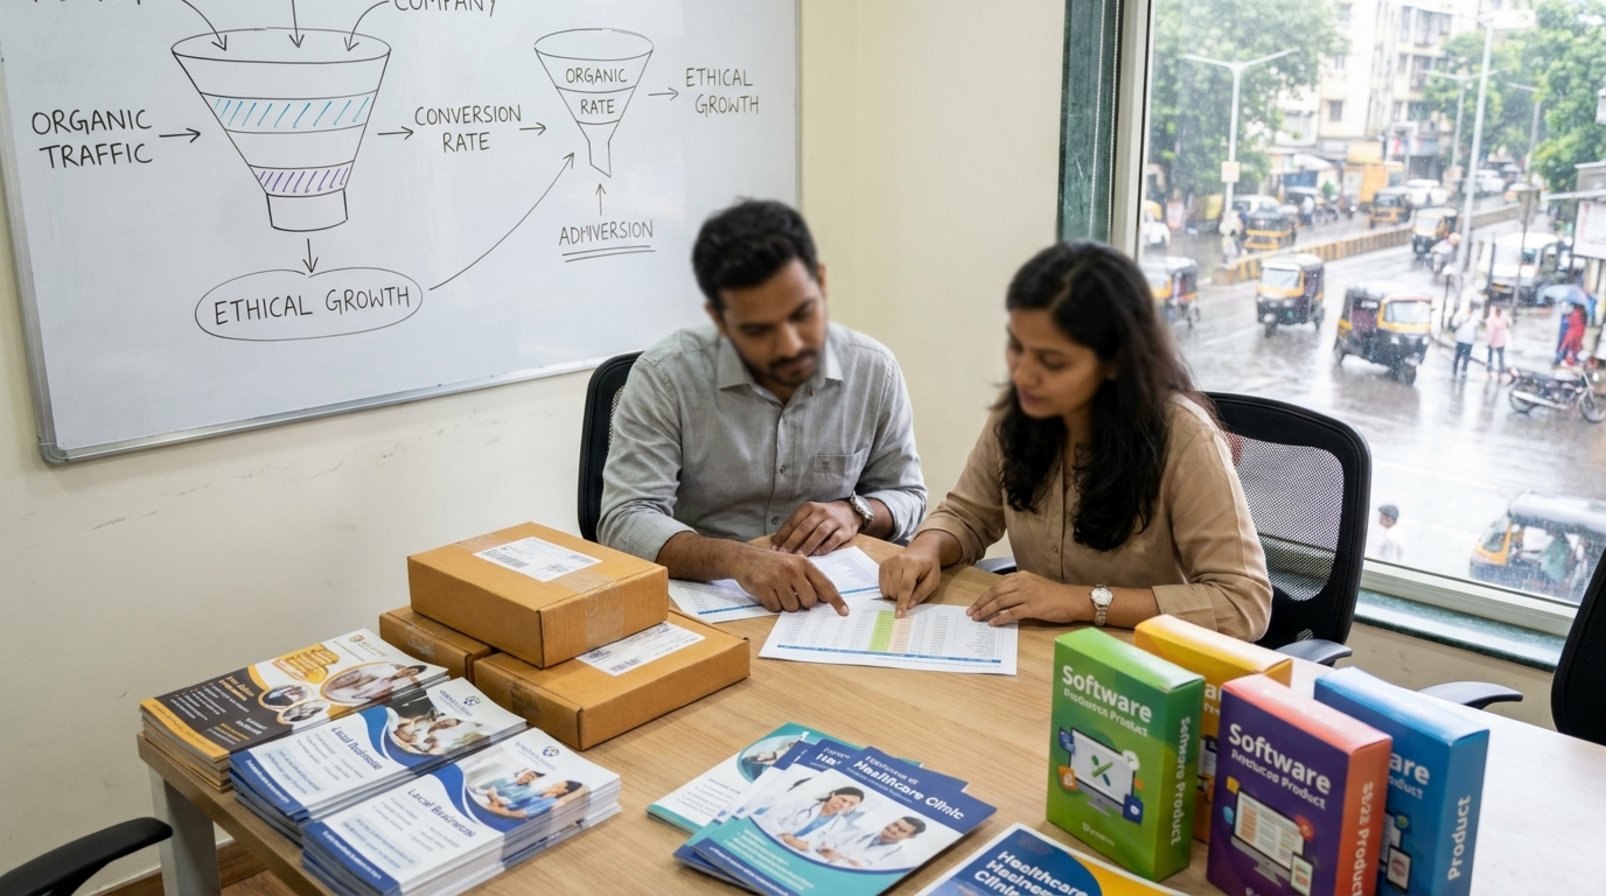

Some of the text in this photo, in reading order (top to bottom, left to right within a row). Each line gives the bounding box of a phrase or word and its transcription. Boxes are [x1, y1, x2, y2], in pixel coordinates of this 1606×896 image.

[565, 67, 628, 85] ORGANIC
[685, 67, 754, 87] ETHICAL
[414, 105, 521, 127] CONVERSION
[580, 98, 615, 115] RATE
[694, 94, 759, 117] GROWTH
[31, 109, 153, 135] ORGANIC
[442, 131, 490, 153] RATE
[39, 143, 153, 168] TRAFFIC
[214, 286, 411, 326] ETHICAL GROWTH
[1062, 665, 1152, 723] Software
[1228, 723, 1331, 795] Software
[1448, 795, 1471, 880] Product
